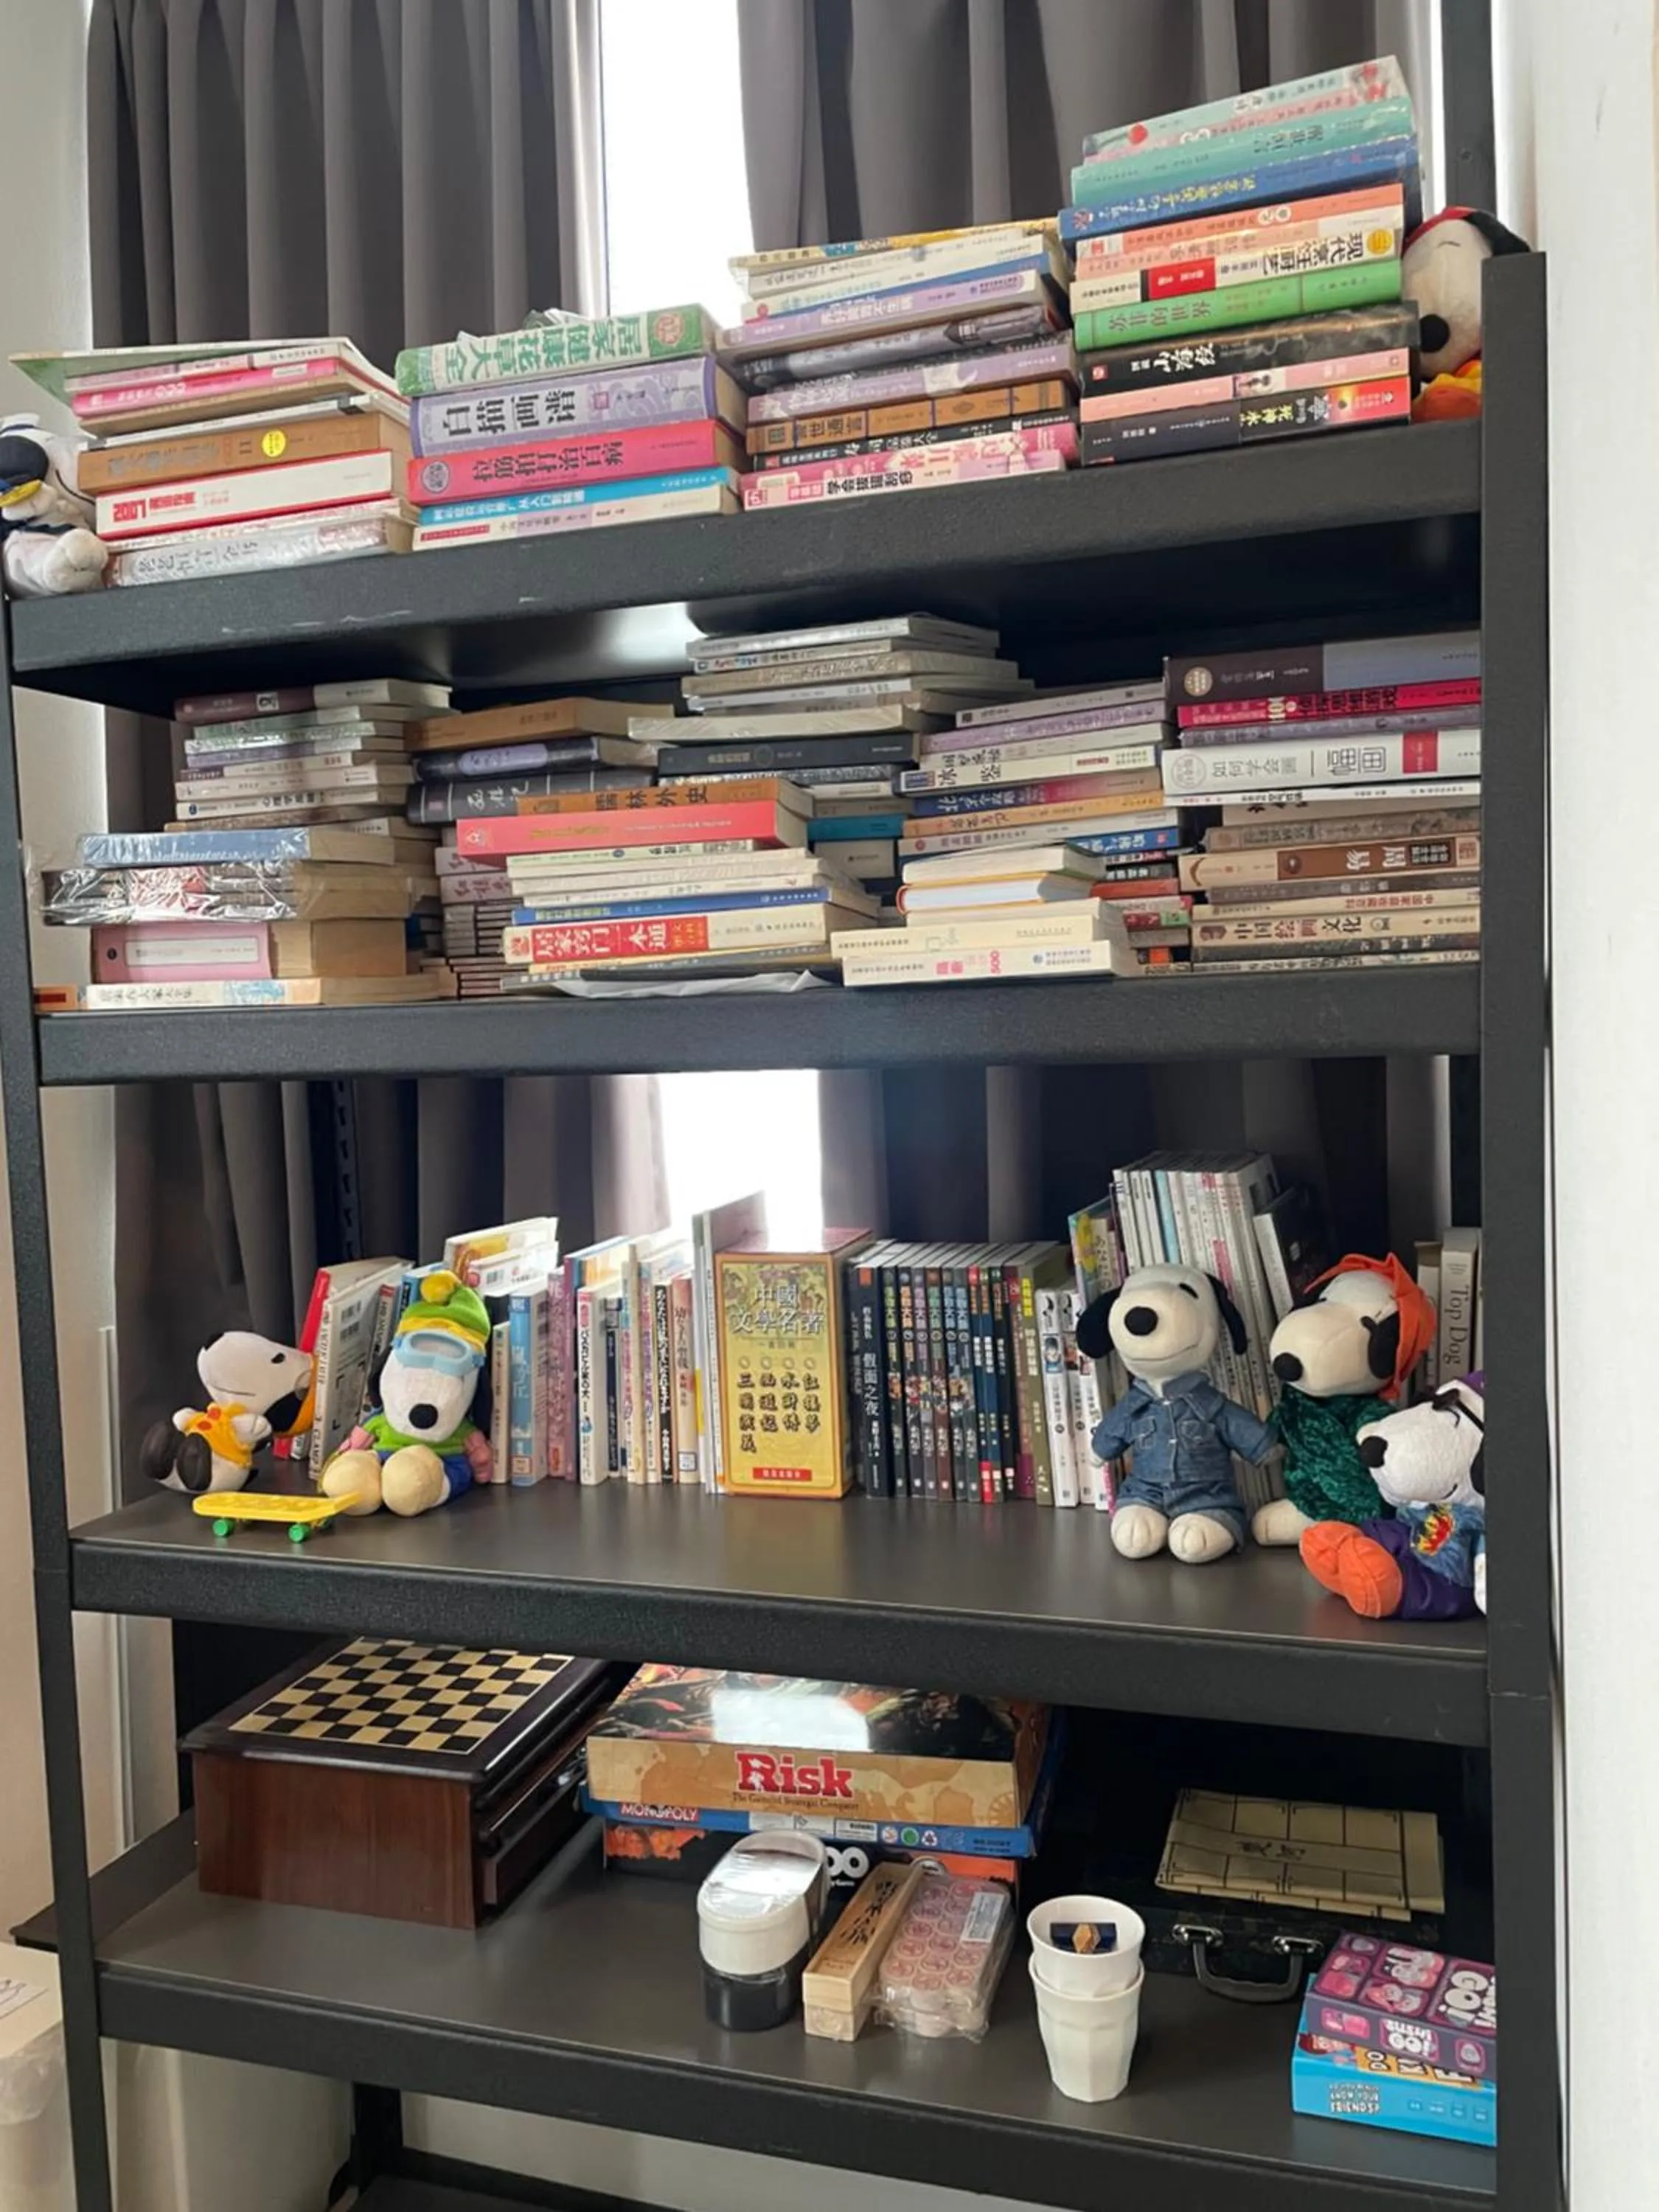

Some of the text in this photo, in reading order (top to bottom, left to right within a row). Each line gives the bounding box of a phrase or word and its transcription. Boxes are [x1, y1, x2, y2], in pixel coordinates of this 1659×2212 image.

[1109, 300, 1211, 332] 苏菲的世界
[445, 318, 641, 384] 居家健康花草大全
[443, 390, 576, 435] 白描画谱
[596, 785, 709, 810] 儒林外史
[1346, 846, 1406, 870] 周易
[1234, 916, 1362, 939] 中国绘画文化
[1443, 1286, 1469, 1364] Top Dog
[736, 1752, 853, 1797] Risk
[621, 1803, 698, 1821] MONOPOLY
